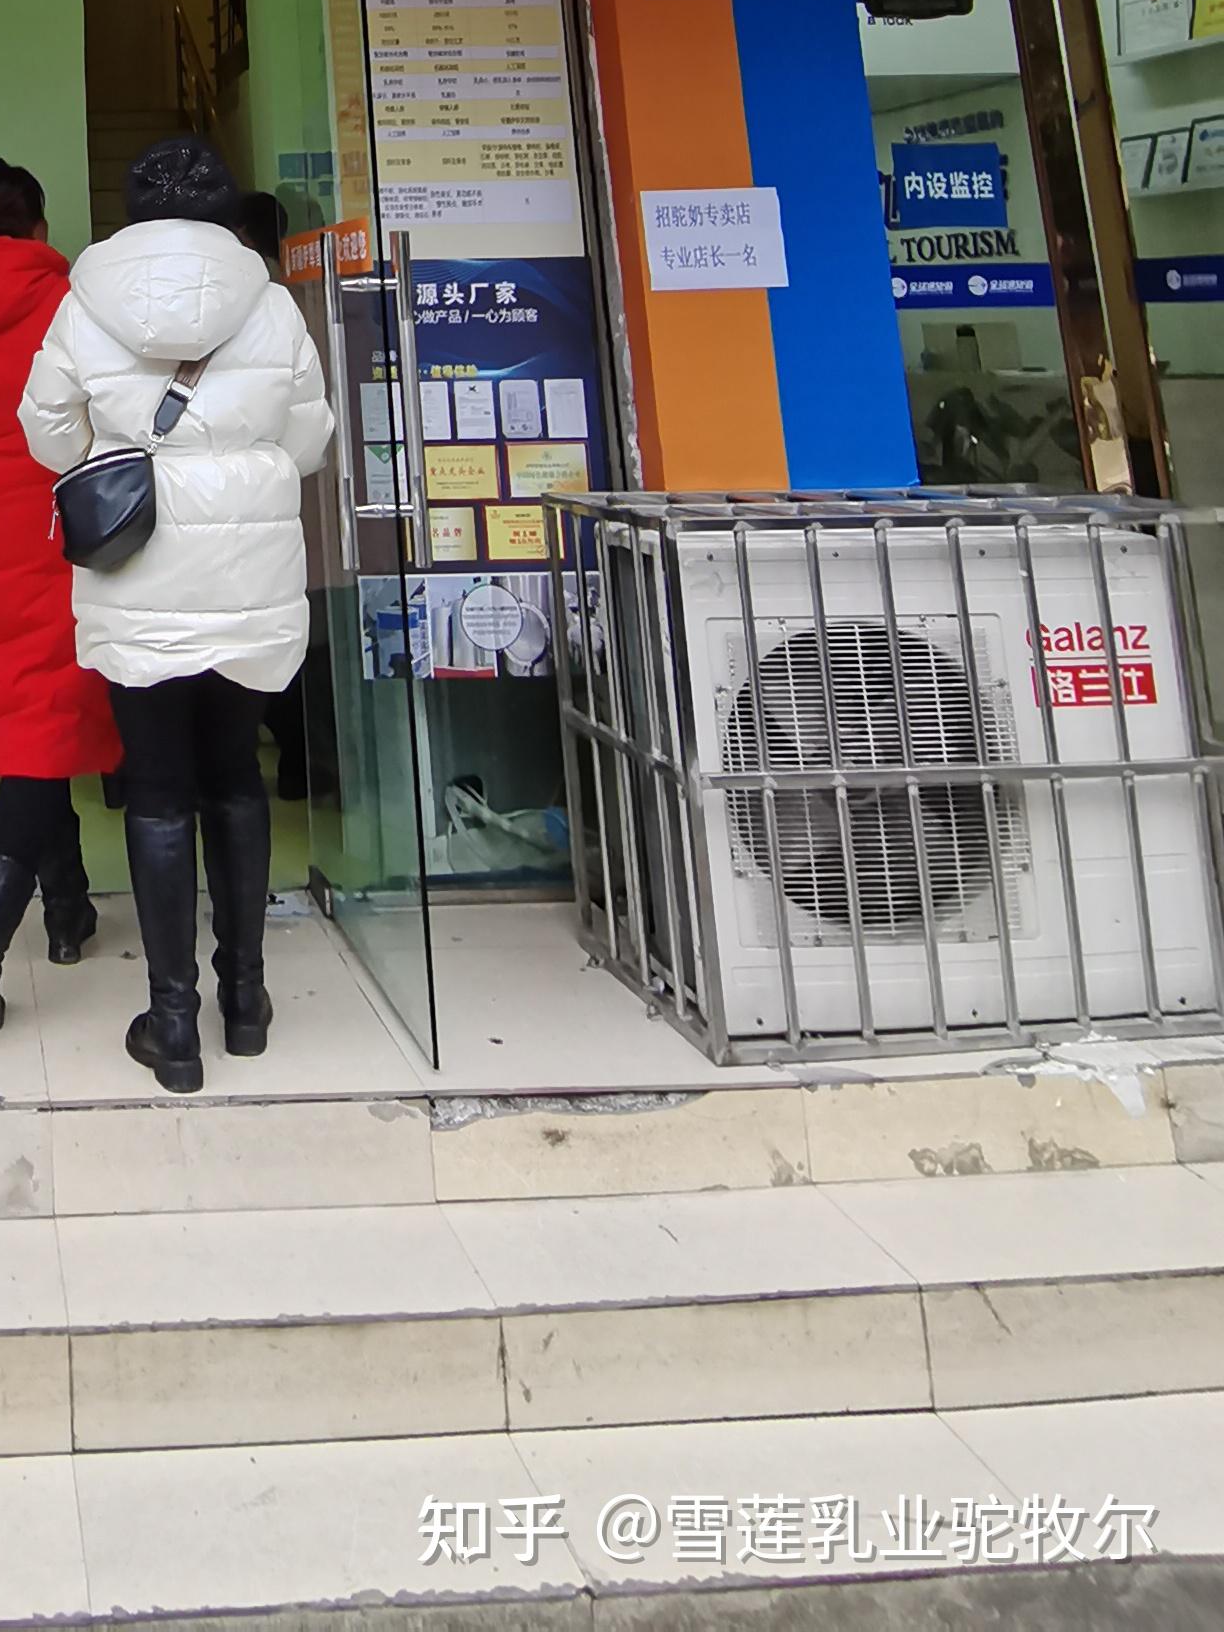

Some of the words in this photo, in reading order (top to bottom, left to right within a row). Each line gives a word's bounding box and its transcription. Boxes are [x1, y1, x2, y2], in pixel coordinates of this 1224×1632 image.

[904, 171, 995, 199] 内设监控
[655, 202, 751, 229] 招驼奶专卖店
[661, 244, 758, 269] 专业店长一名
[901, 229, 1021, 263] TOURISM
[416, 281, 518, 306] 源头厂家
